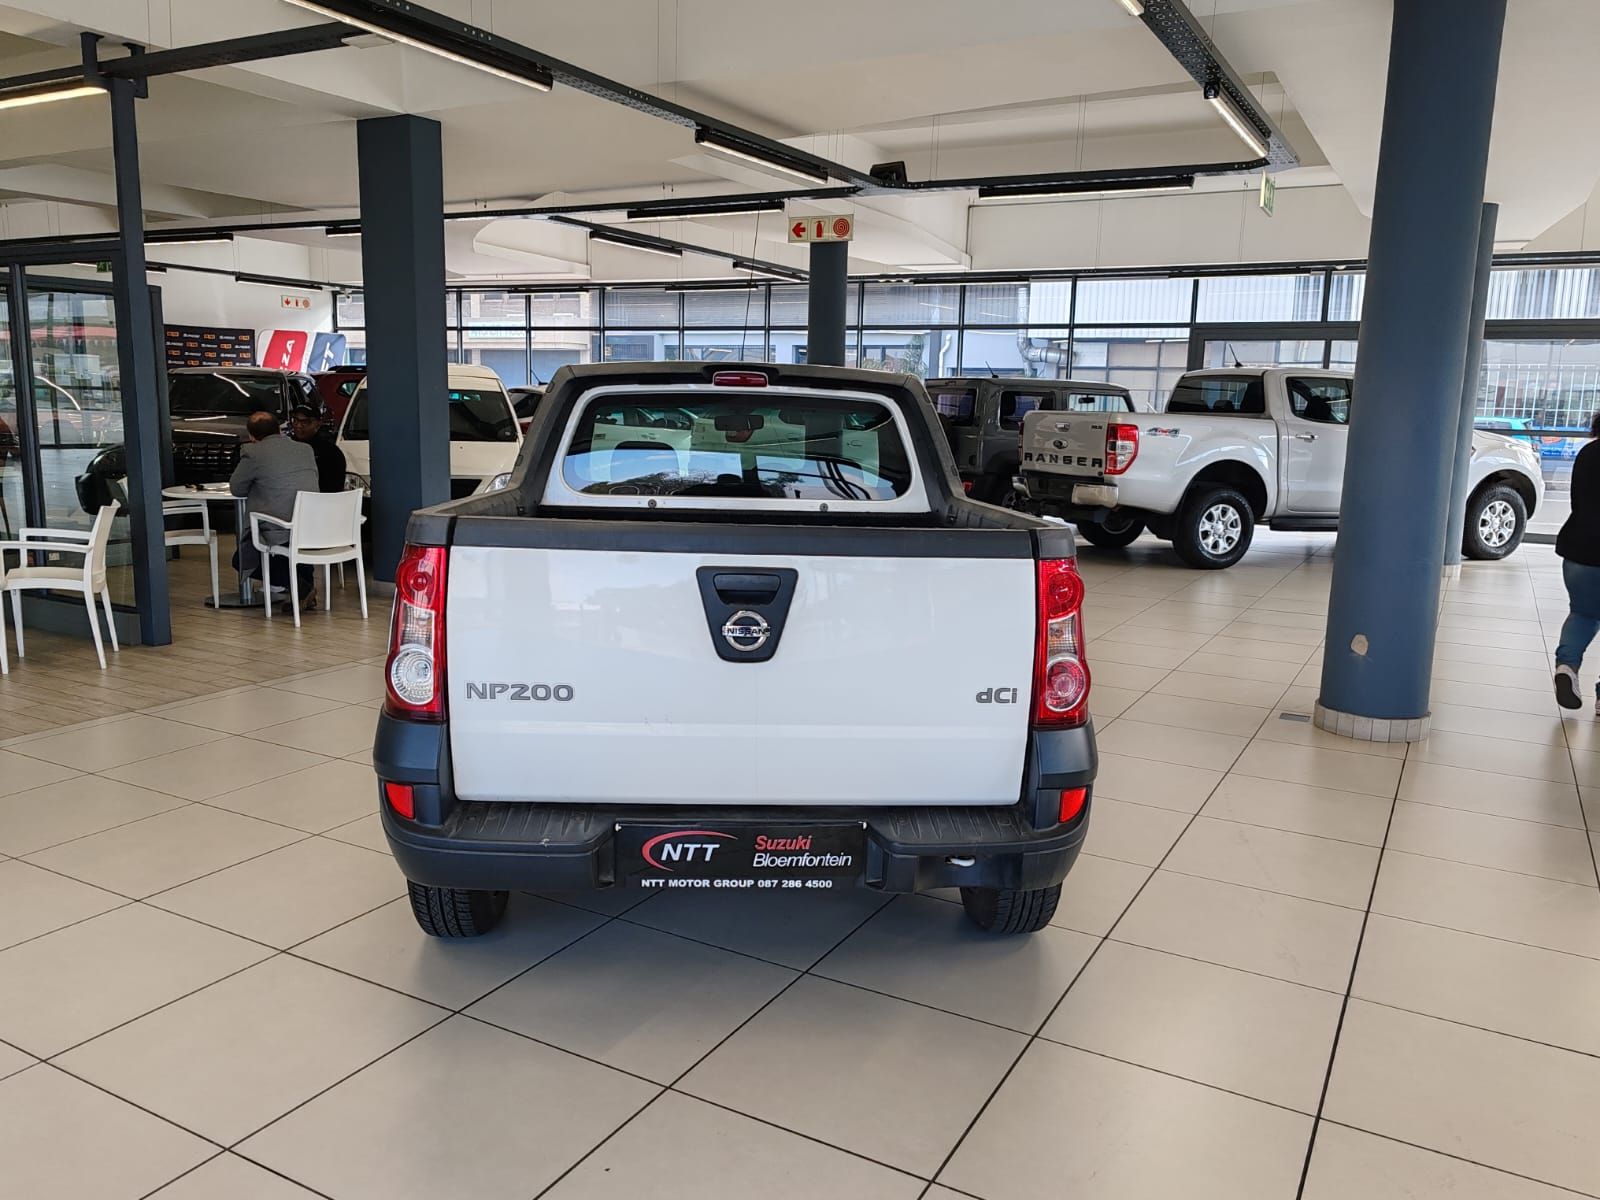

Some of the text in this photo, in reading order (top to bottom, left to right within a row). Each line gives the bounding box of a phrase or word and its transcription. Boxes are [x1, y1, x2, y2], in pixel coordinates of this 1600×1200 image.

[1024, 452, 1103, 468] RANGER
[725, 626, 769, 636] NISSAN
[466, 682, 574, 701] NP200
[976, 687, 1018, 704] dCi
[755, 835, 812, 850] Suzuki
[661, 843, 720, 861] NTT
[753, 852, 852, 867] Bloemfontein
[641, 879, 833, 888] NTT MOTOR GROUP 087 286 4500
